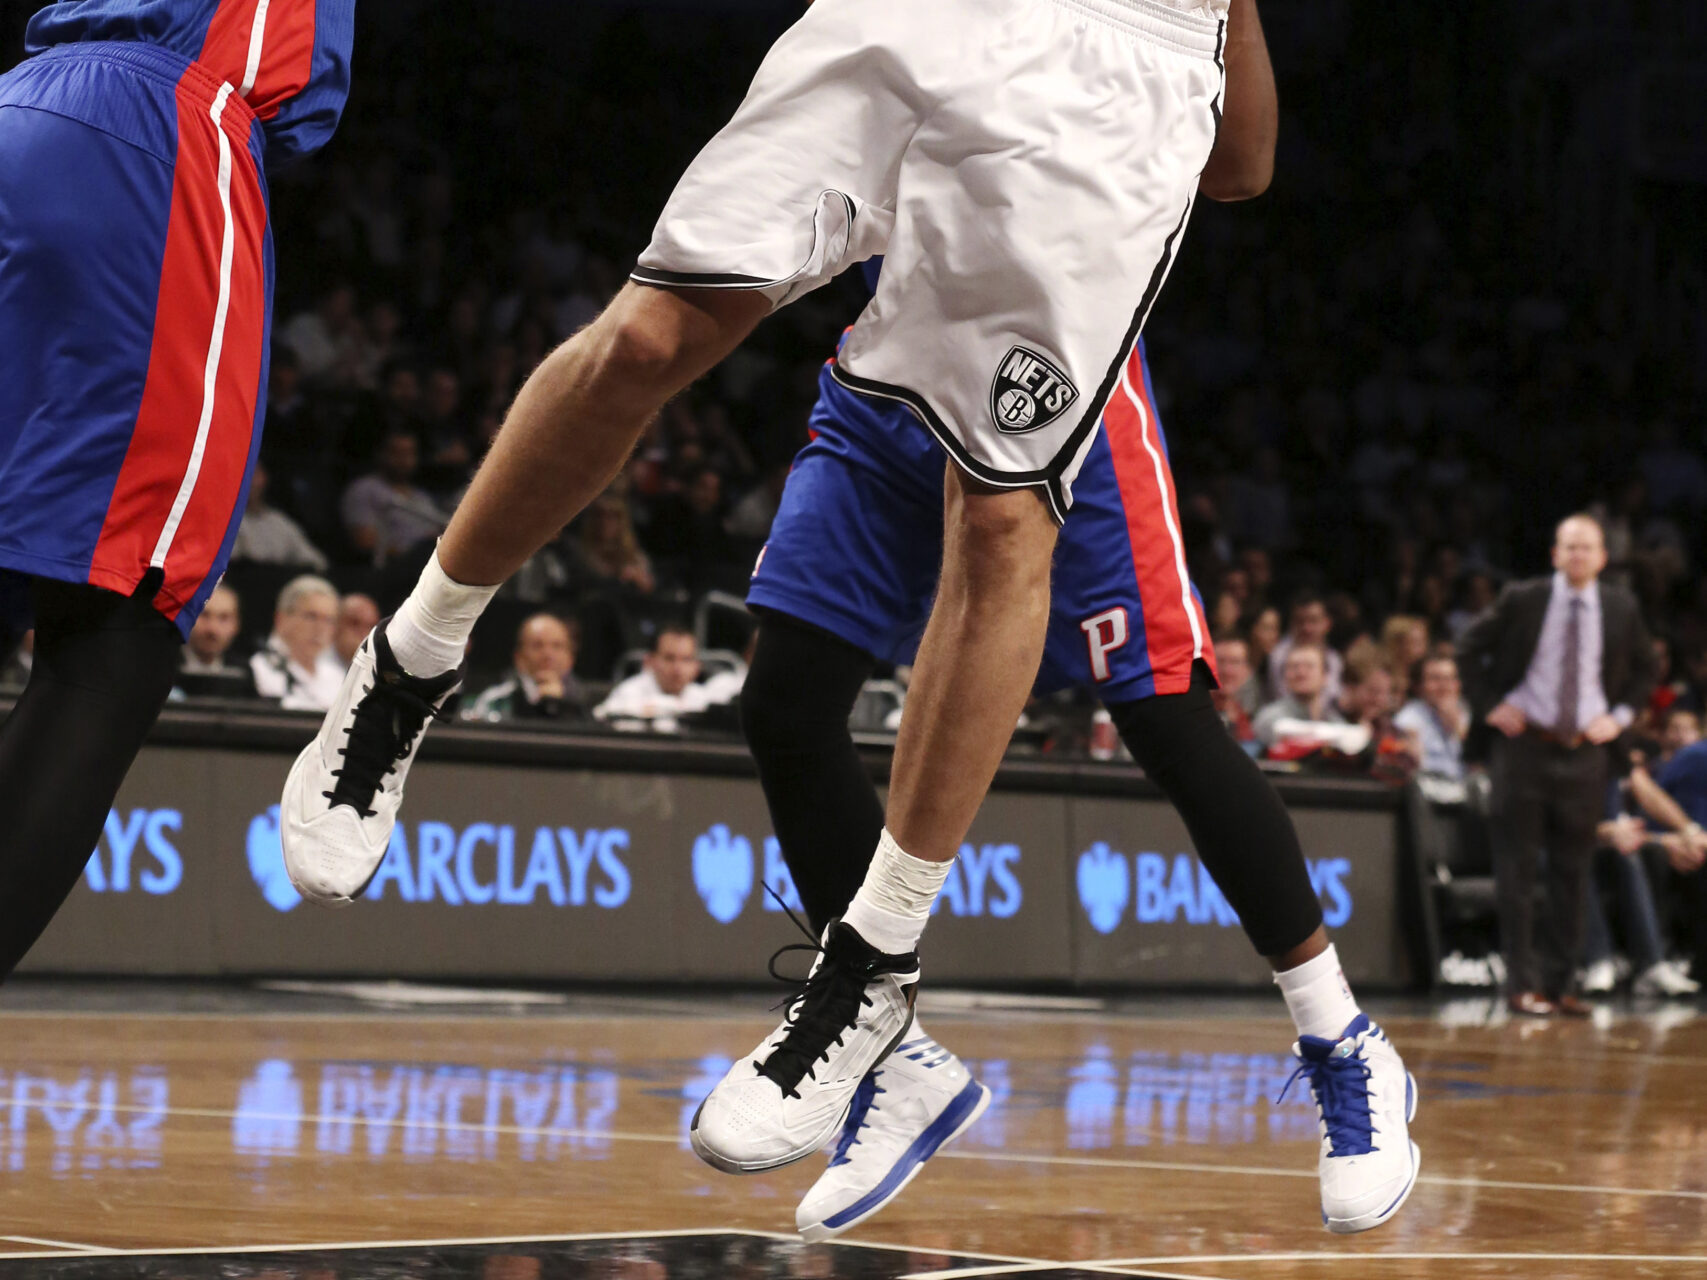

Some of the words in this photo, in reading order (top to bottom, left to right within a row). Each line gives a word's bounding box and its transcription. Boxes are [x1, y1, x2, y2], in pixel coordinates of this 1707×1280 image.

[1001, 351, 1072, 413] NETS
[1080, 606, 1130, 683] P
[365, 819, 632, 908] ARCLAYS
